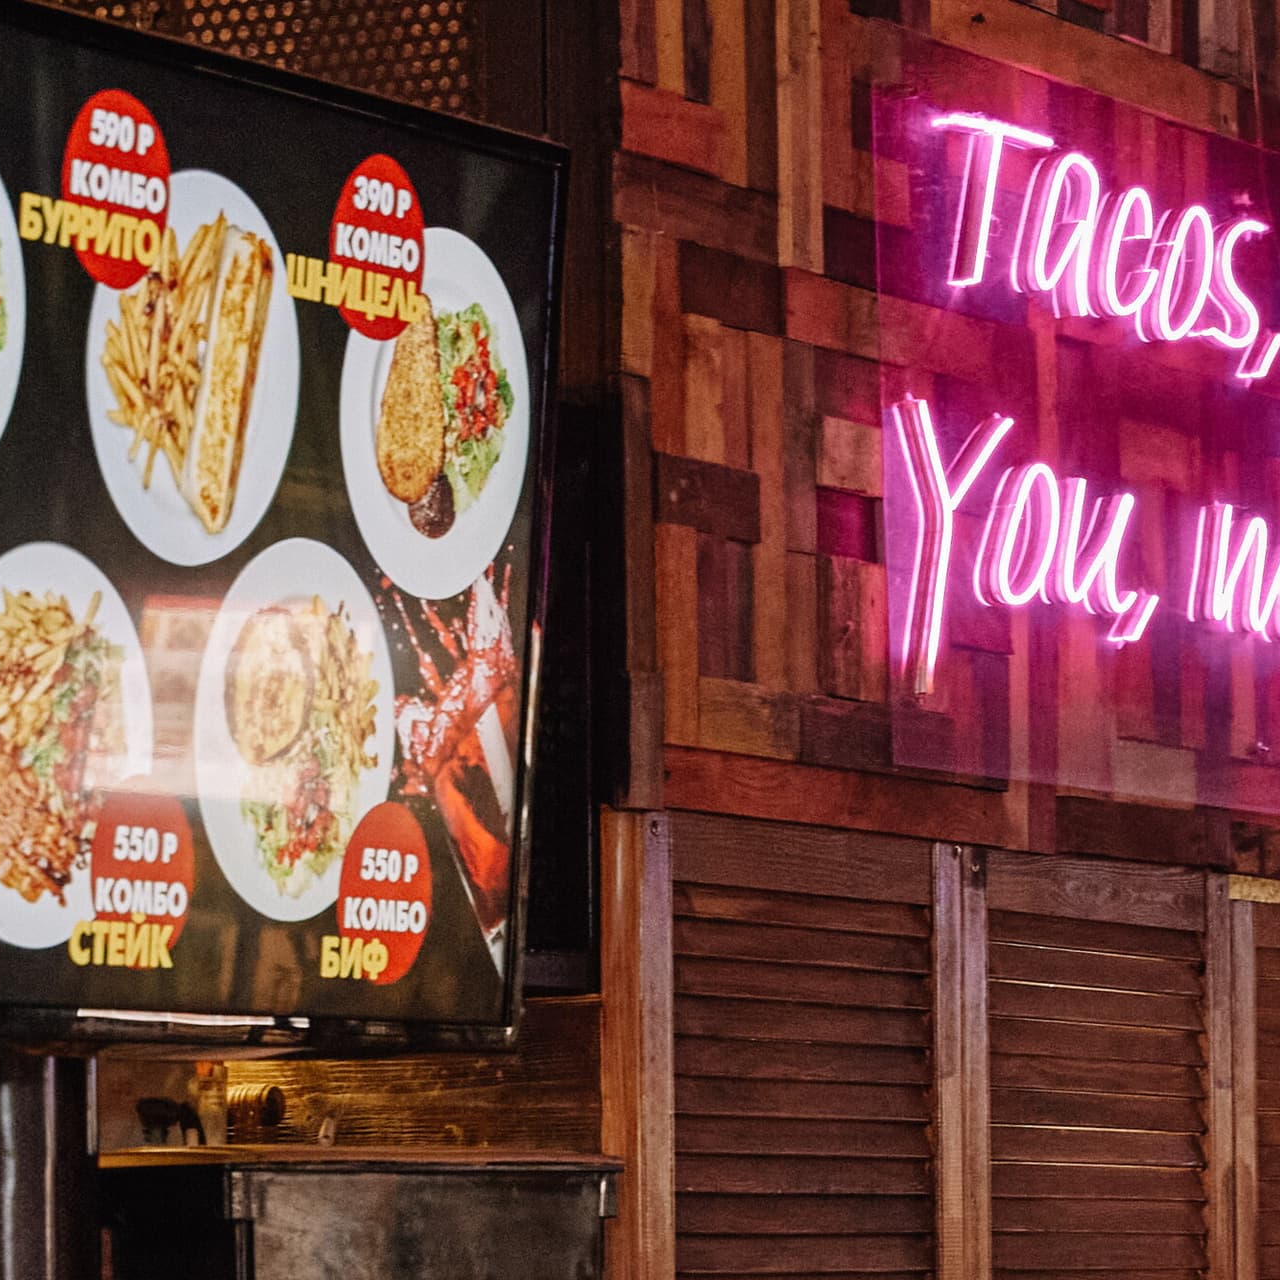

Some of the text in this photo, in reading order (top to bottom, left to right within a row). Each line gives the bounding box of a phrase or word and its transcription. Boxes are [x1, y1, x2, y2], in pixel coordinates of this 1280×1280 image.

[88, 107, 155, 156] 590 Р
[70, 158, 167, 214] КОМБО
[353, 175, 412, 219] 390 Р
[19, 191, 162, 267] БУРРИТО
[334, 222, 420, 273] КОМБО
[285, 252, 426, 323] ШНИЦЕЛЬ
[891, 393, 1161, 697] You,
[113, 824, 179, 864] 550 Р
[360, 847, 419, 883] 550 Р
[95, 876, 188, 917] КОМБО
[343, 896, 427, 934] КОМБО
[68, 912, 174, 969] СТЕЙК
[320, 935, 389, 981] БИФ
